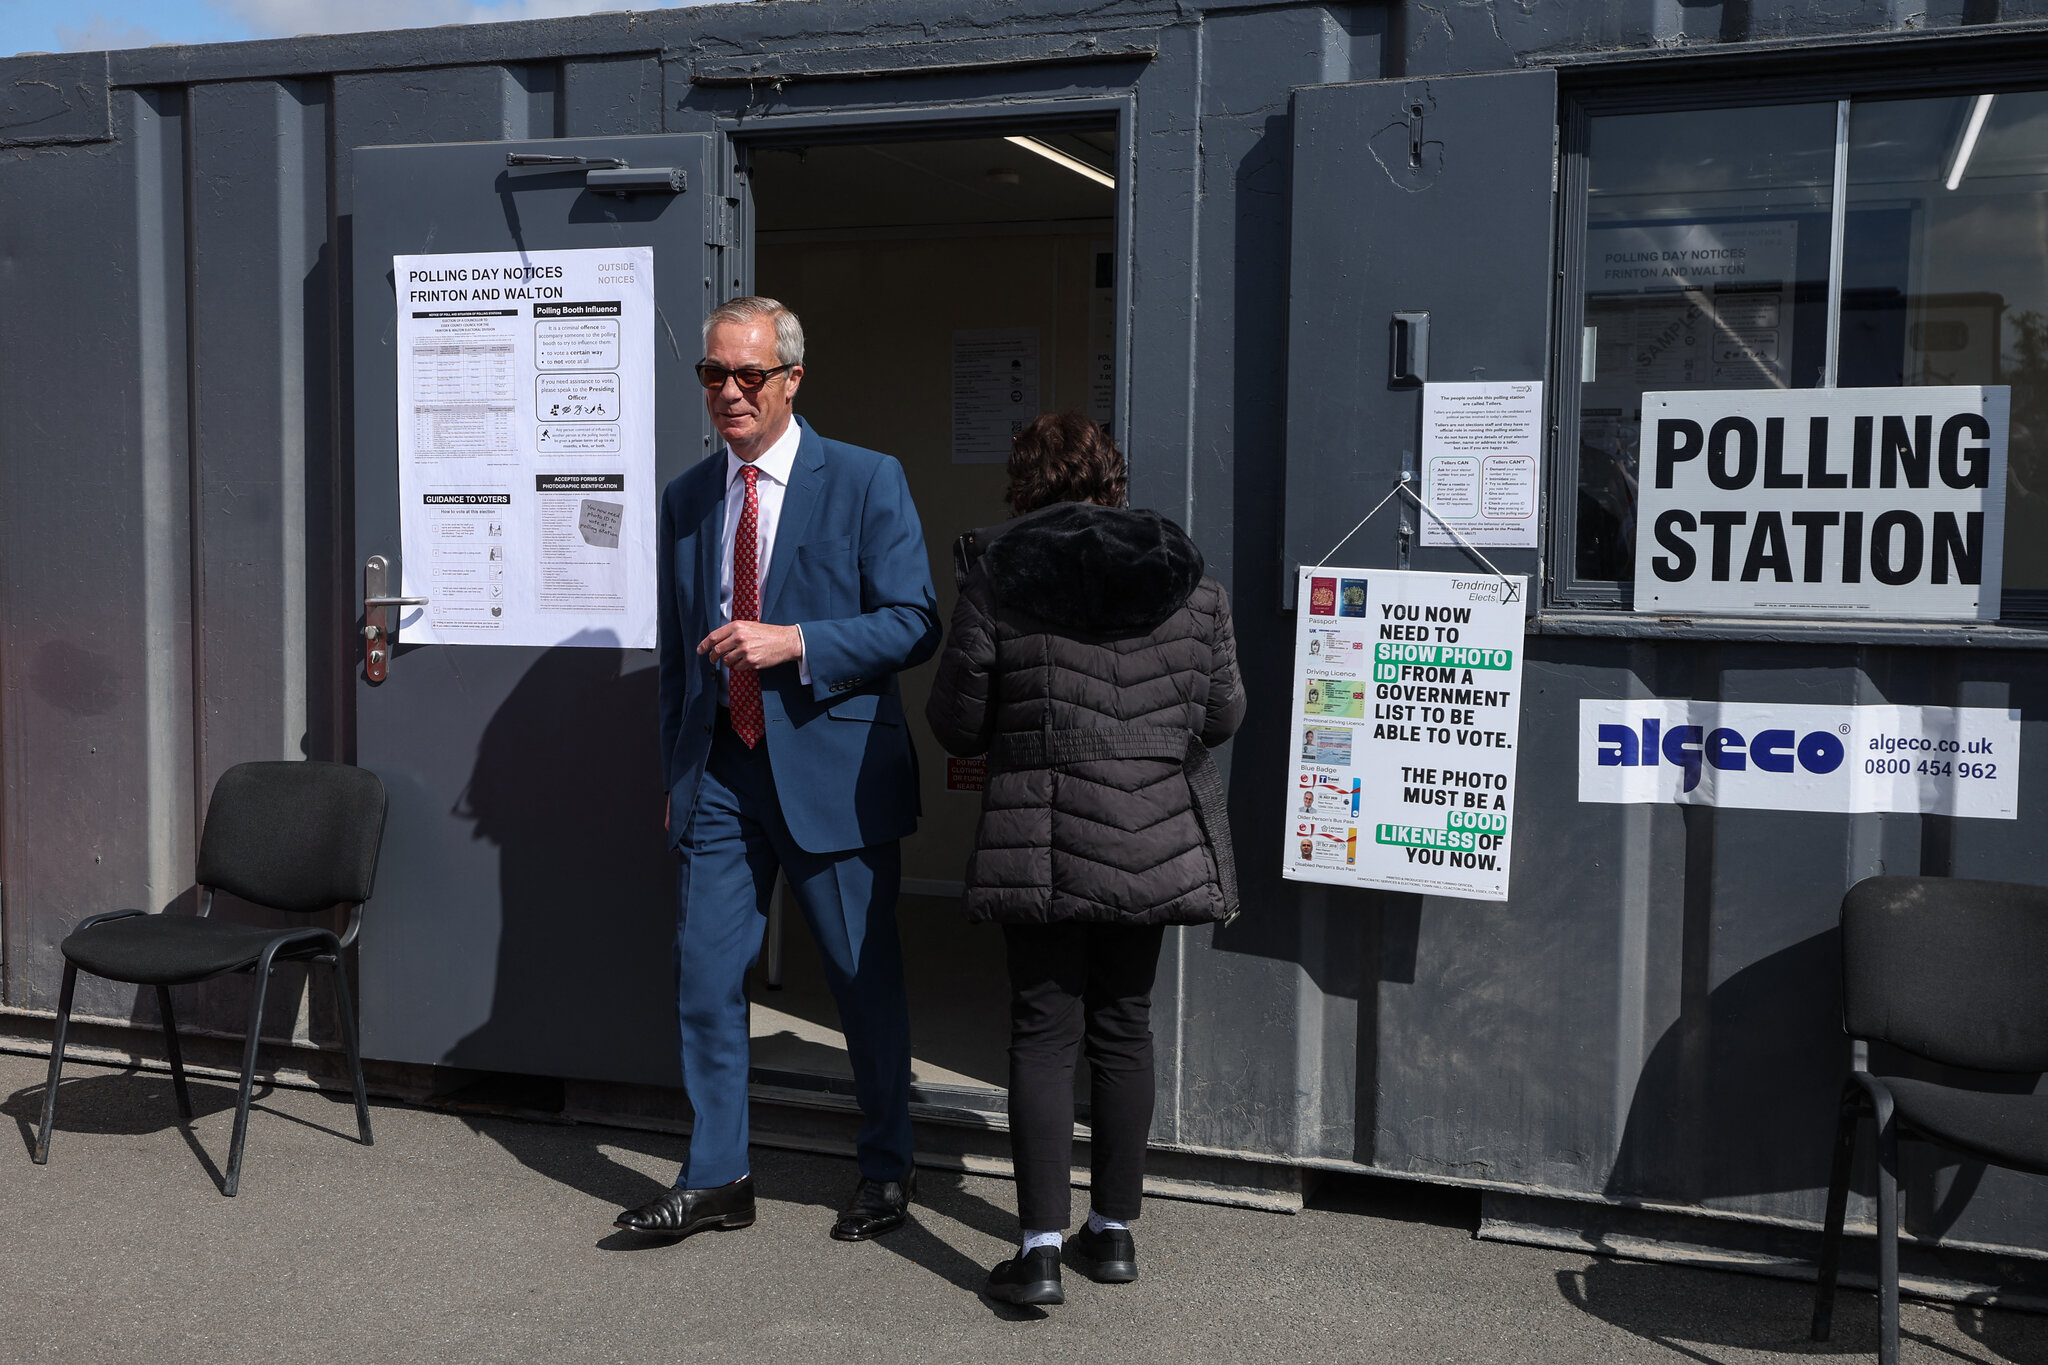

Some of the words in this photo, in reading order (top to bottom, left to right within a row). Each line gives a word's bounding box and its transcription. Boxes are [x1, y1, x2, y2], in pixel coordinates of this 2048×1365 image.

[1605, 252, 1658, 263] POLLING
[1662, 251, 1687, 261] DAY
[1691, 249, 1746, 260] NOTICES
[410, 270, 467, 282] POLLING
[472, 269, 498, 281] DAY
[504, 266, 562, 280] NOTICES
[598, 263, 634, 272] OUTSIDE
[1605, 268, 1658, 279] FRINTON
[1662, 267, 1688, 277] AND
[1690, 264, 1745, 276] WALTON
[598, 276, 634, 284] NOTICES
[411, 289, 468, 302] FRINTON
[472, 288, 499, 300] AND
[504, 286, 562, 299] WALTON
[1640, 303, 1703, 367] SAMPLE
[1655, 413, 1990, 490] POLLING
[580, 524, 597, 533] polling
[1652, 509, 1984, 586] STATION
[1452, 580, 1498, 593] Tendring
[1469, 593, 1495, 601] Elects
[1381, 604, 1419, 621] YOU
[1425, 606, 1471, 623] NOW
[1380, 624, 1428, 641] NEED
[1435, 626, 1459, 643] TO
[1378, 644, 1436, 663] SHOW
[1442, 647, 1507, 667] PHOTO
[1378, 663, 1396, 680] ID
[1402, 665, 1455, 684] FROM
[1461, 669, 1474, 684] A
[1376, 684, 1510, 707] GOVERNMENT
[1375, 704, 1416, 721] LIST
[1421, 706, 1444, 723] TO
[1451, 708, 1474, 725] BE
[1374, 724, 1420, 742] ABLE
[1426, 727, 1450, 744] TO
[1456, 730, 1512, 749] VOTE.
[1869, 734, 1993, 756] algeco.co.uk
[1598, 718, 1844, 793] algeco
[1401, 767, 1437, 784] THE
[1442, 770, 1507, 790] PHOTO
[1865, 758, 1911, 774] 0800
[1917, 760, 1953, 778] 454
[1958, 763, 1997, 780] 962
[1404, 787, 1458, 806] MUST
[1464, 792, 1488, 809] BE
[1493, 795, 1505, 810] A
[1450, 812, 1505, 830] GOOD
[1381, 825, 1474, 848] LIKENESS
[1479, 834, 1504, 850] OF
[1406, 847, 1444, 866] YOU
[1450, 852, 1501, 871] NOW.
